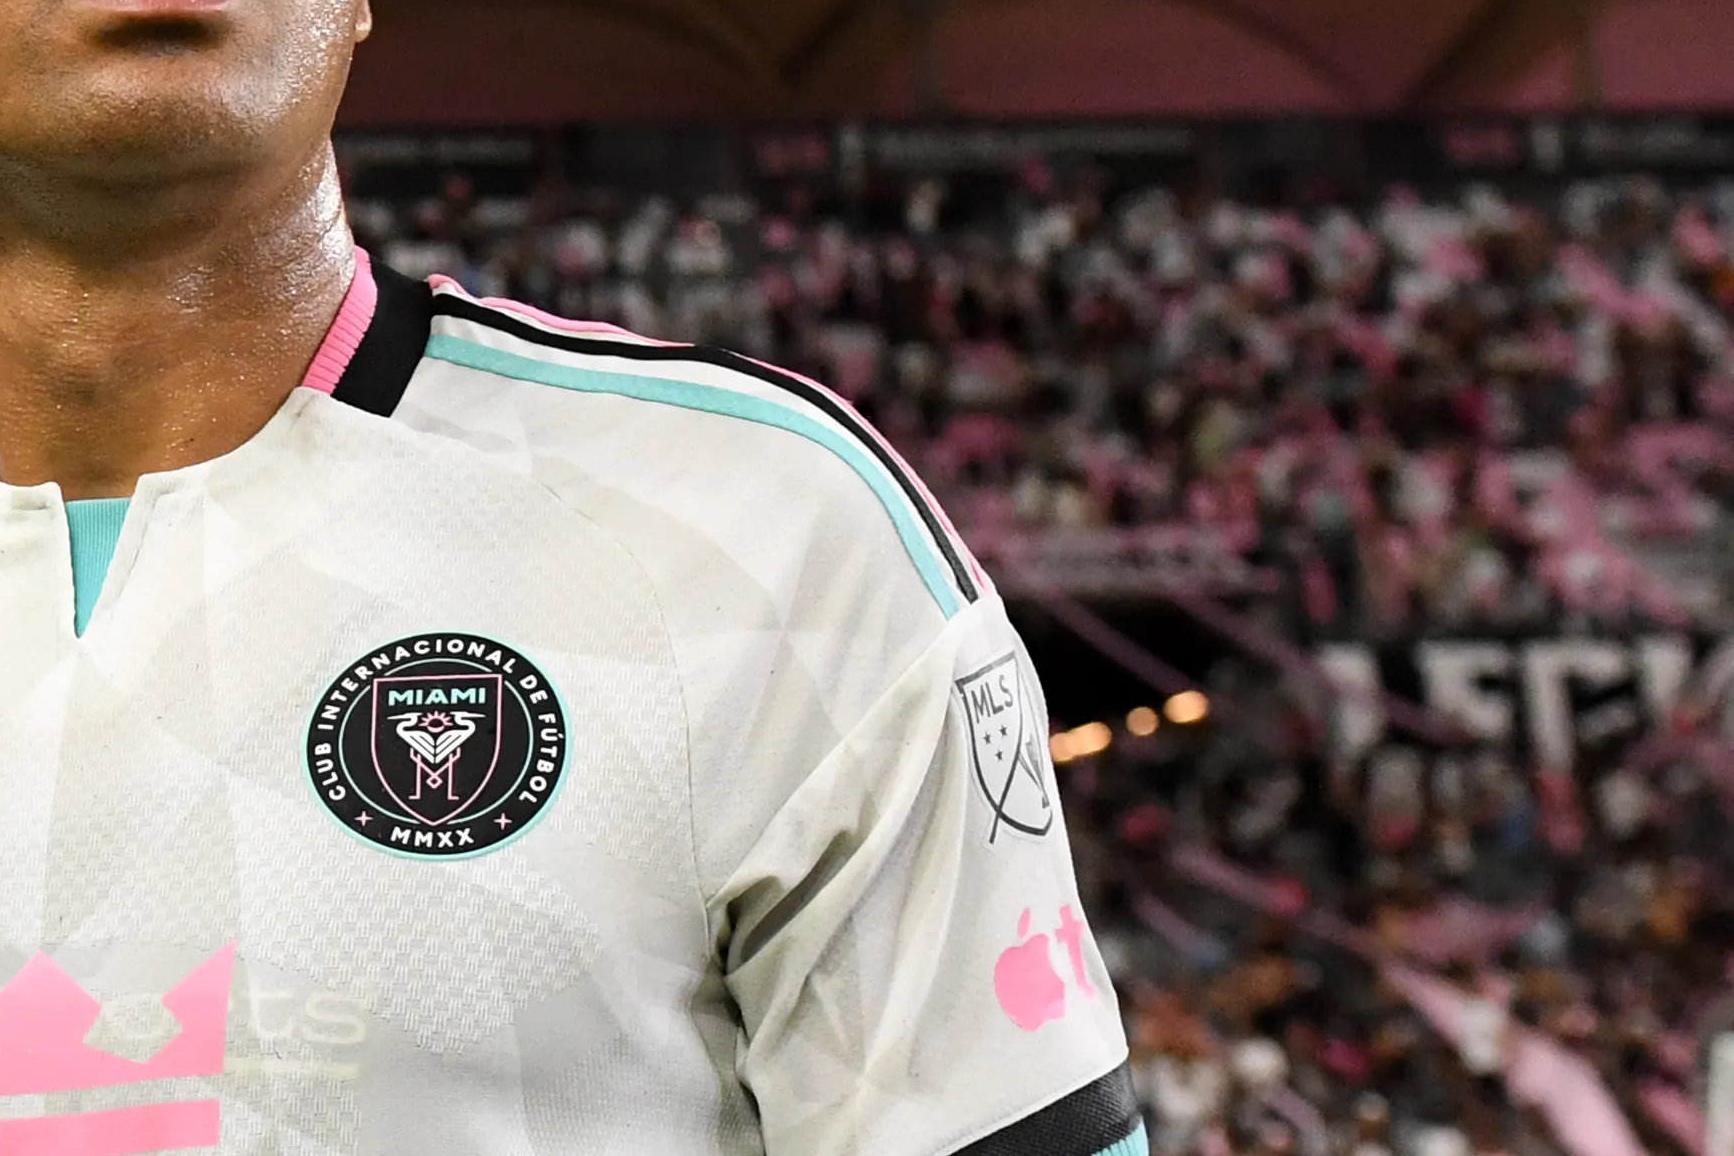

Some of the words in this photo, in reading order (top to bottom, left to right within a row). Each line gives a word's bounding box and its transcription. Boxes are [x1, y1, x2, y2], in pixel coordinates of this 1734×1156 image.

[317, 638, 517, 731] INTERNACIONAL
[387, 687, 487, 707] MIAMI
[518, 673, 549, 705] DE
[970, 673, 1016, 724] MLS
[314, 742, 347, 801] CLUB
[518, 712, 565, 805] FÚTBOL
[389, 825, 475, 848] MMXX
